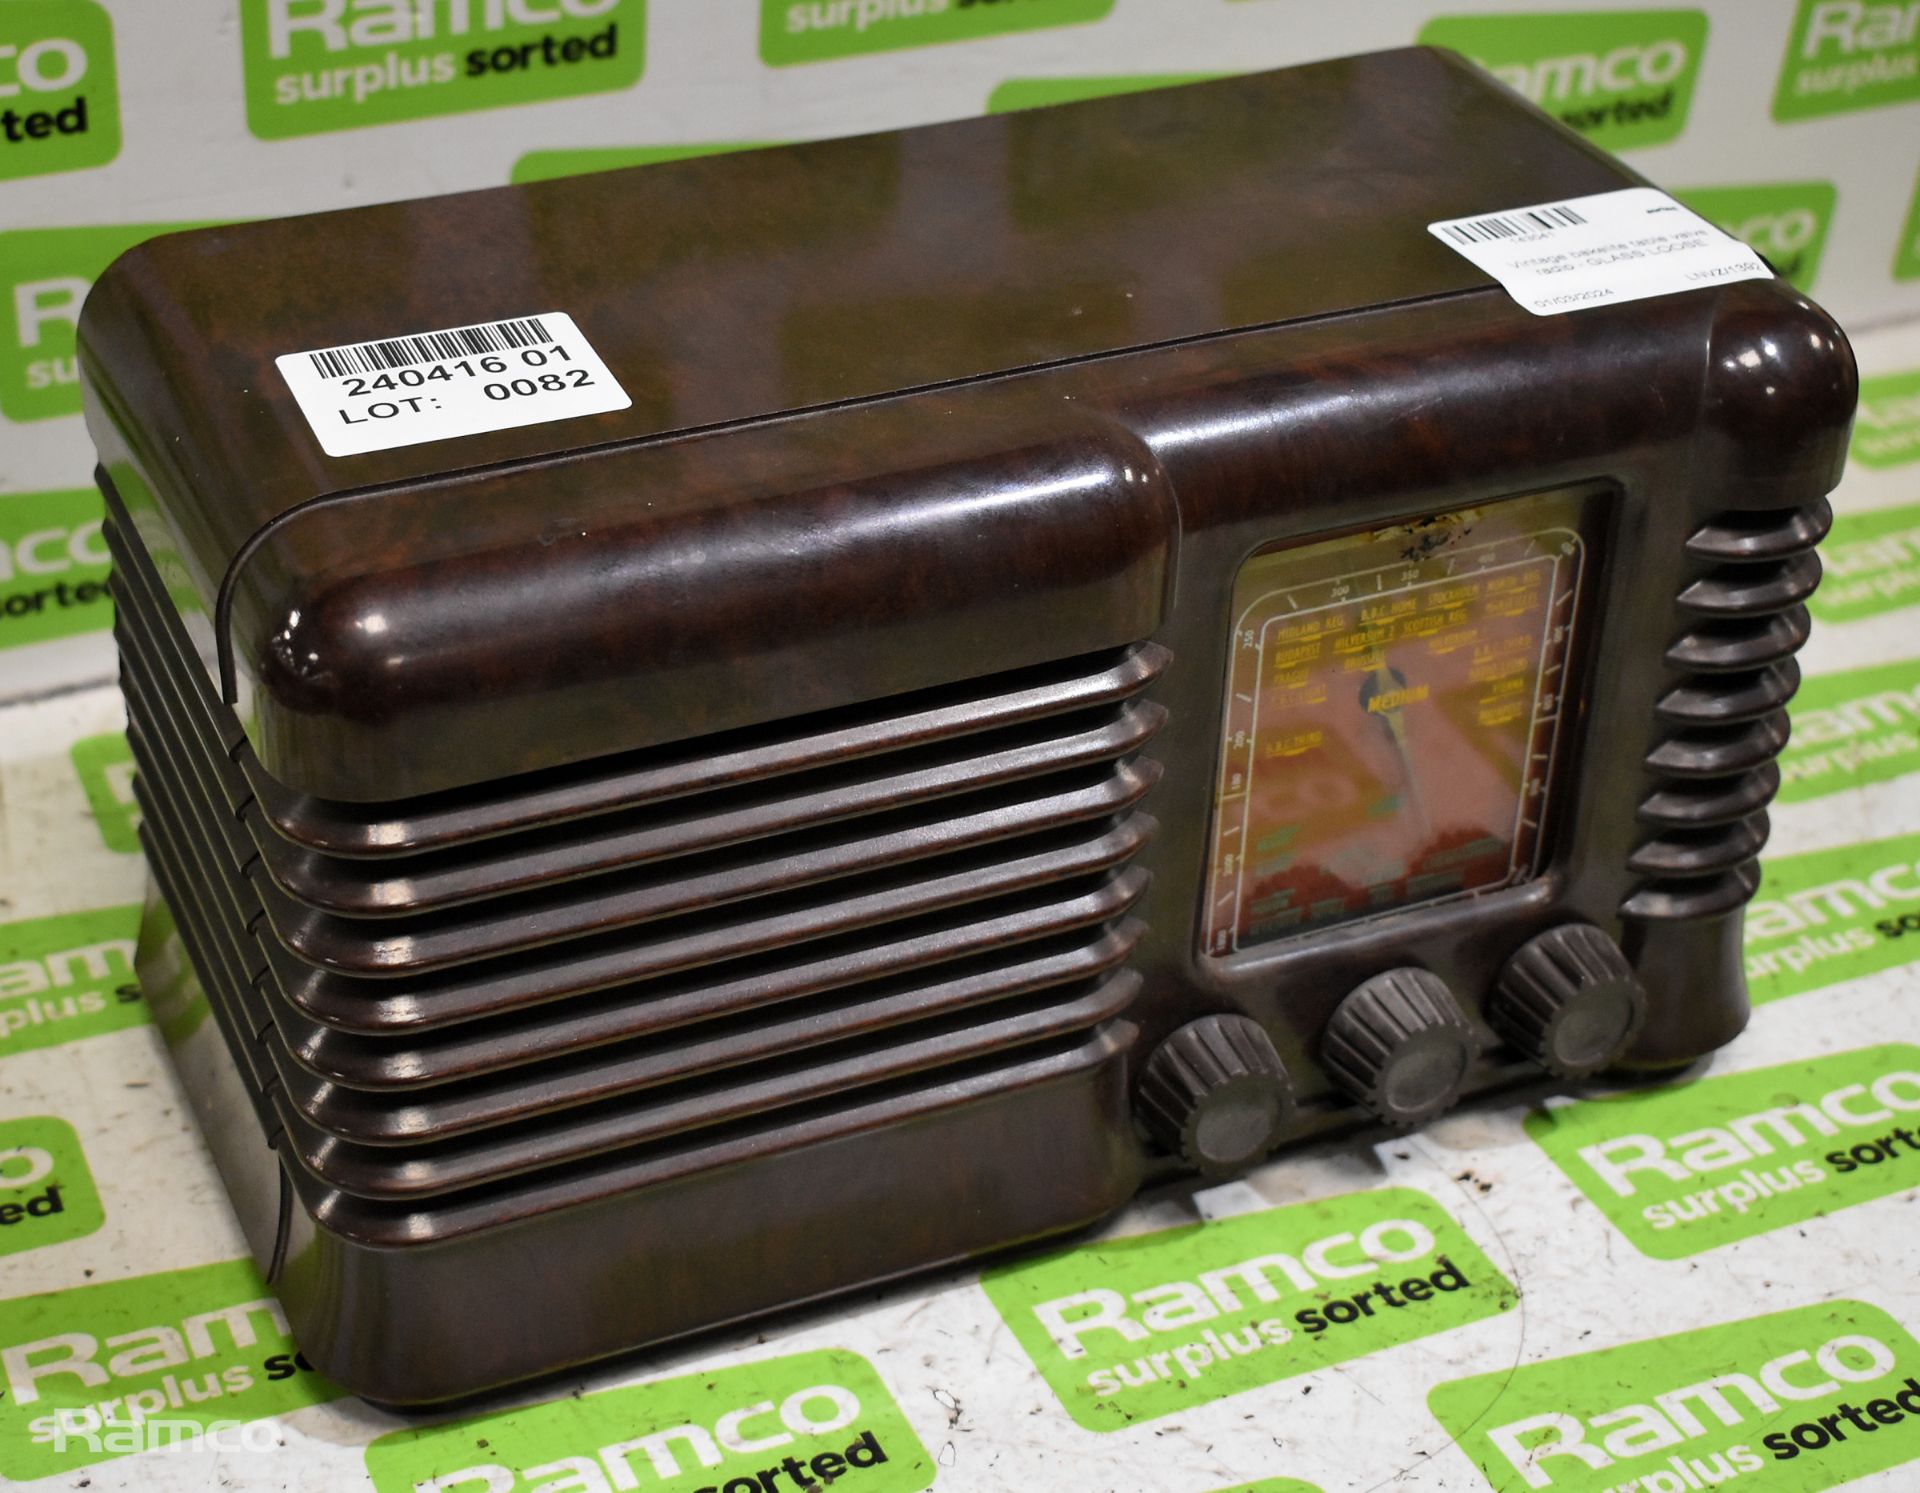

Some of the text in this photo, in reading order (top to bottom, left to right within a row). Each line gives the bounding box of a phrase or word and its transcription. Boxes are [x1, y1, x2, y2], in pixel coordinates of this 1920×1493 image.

[1802, 0, 1920, 59] Ra
[276, 24, 617, 104] surplus sorted
[1472, 38, 1688, 106] amco
[1586, 248, 1646, 269] GLASS
[338, 368, 597, 425] LOT: 0082
[341, 345, 573, 397] 240416 01
[1330, 585, 1350, 598] 300
[1641, 1126, 1920, 1231] surplus sort
[1032, 1218, 1436, 1362] Ramco
[1086, 1260, 1471, 1397] surplus sorted
[1487, 1335, 1897, 1489] Ramco
